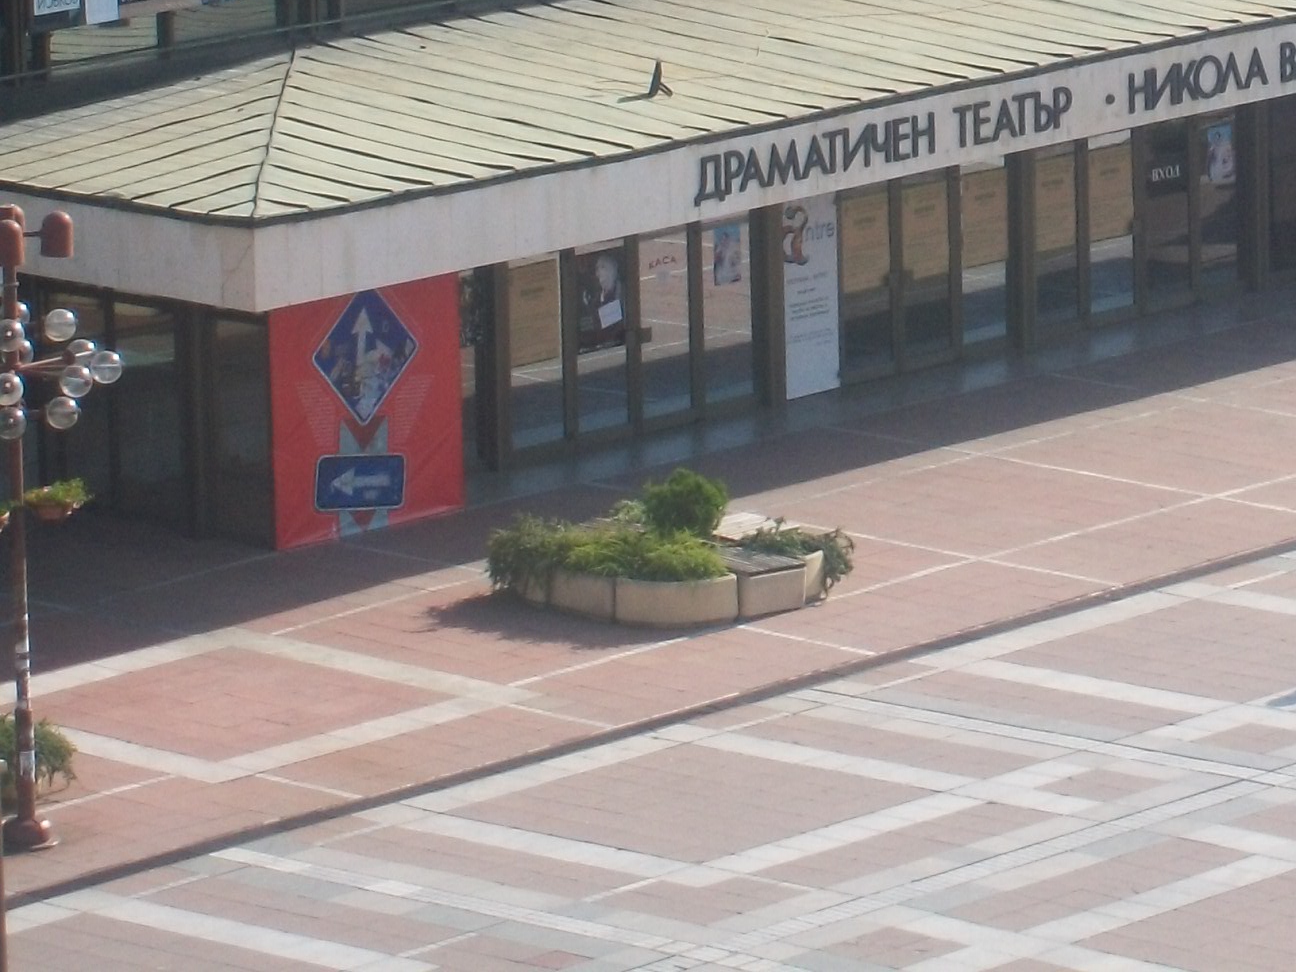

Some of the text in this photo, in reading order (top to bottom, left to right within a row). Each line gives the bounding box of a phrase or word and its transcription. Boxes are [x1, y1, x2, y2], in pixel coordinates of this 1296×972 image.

[694, 112, 936, 206] ДРАМАТИЧЕН
[953, 86, 1073, 148] ТЕАТЪР
[1128, 47, 1269, 114] НИКОЛА
